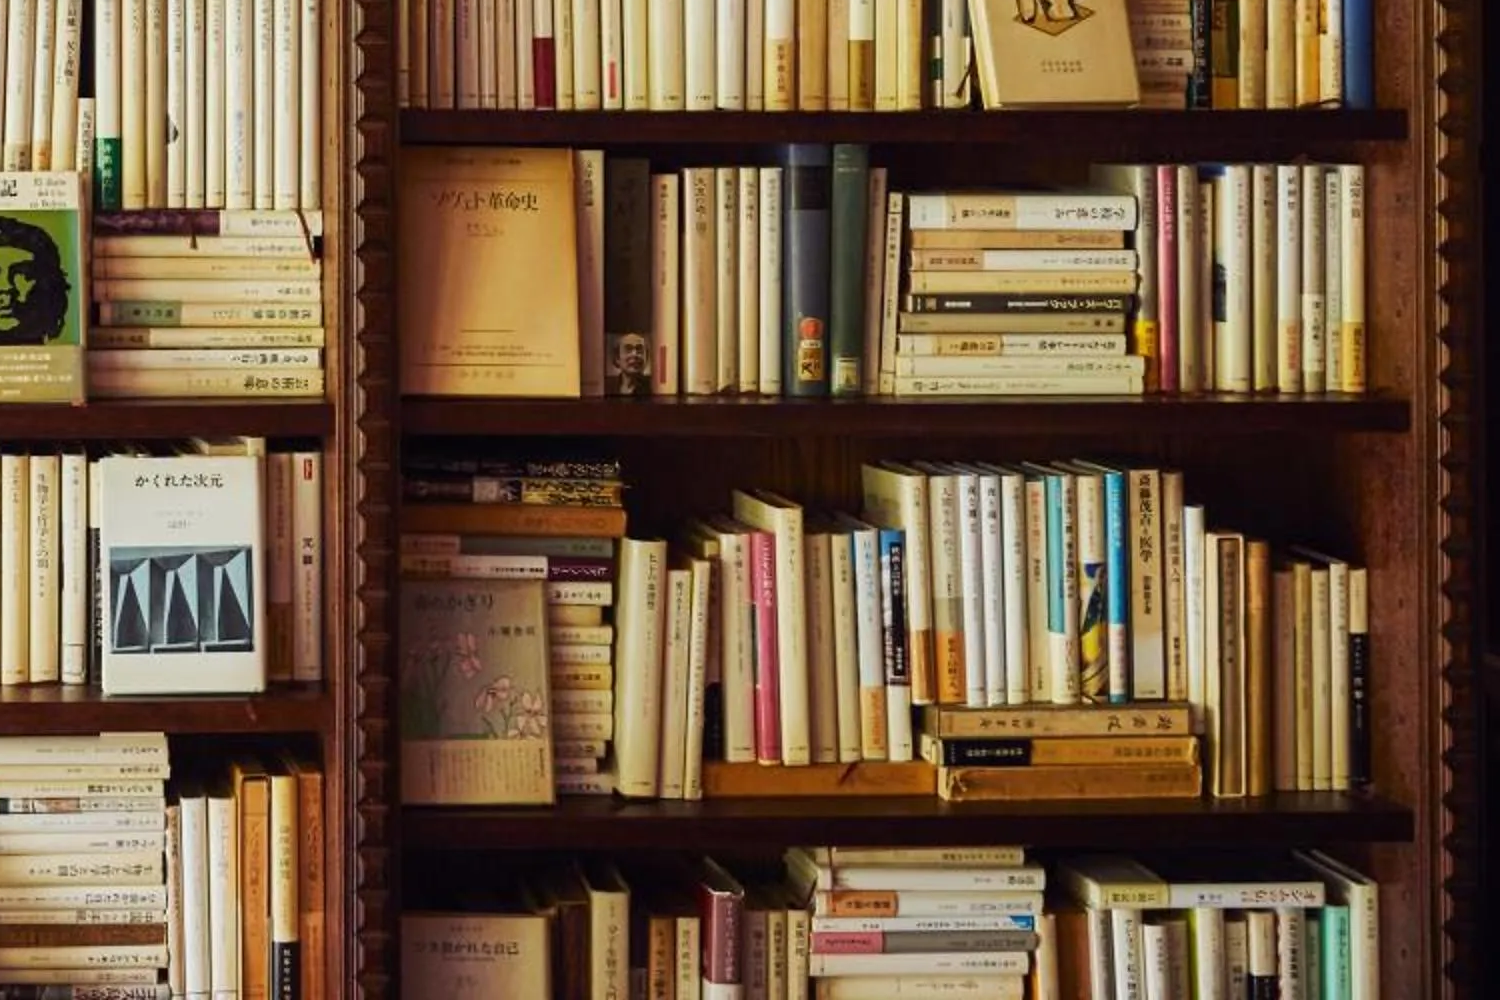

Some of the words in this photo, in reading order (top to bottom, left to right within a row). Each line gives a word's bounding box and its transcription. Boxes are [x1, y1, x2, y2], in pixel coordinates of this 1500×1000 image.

[135, 473, 225, 489] かくれた次元
